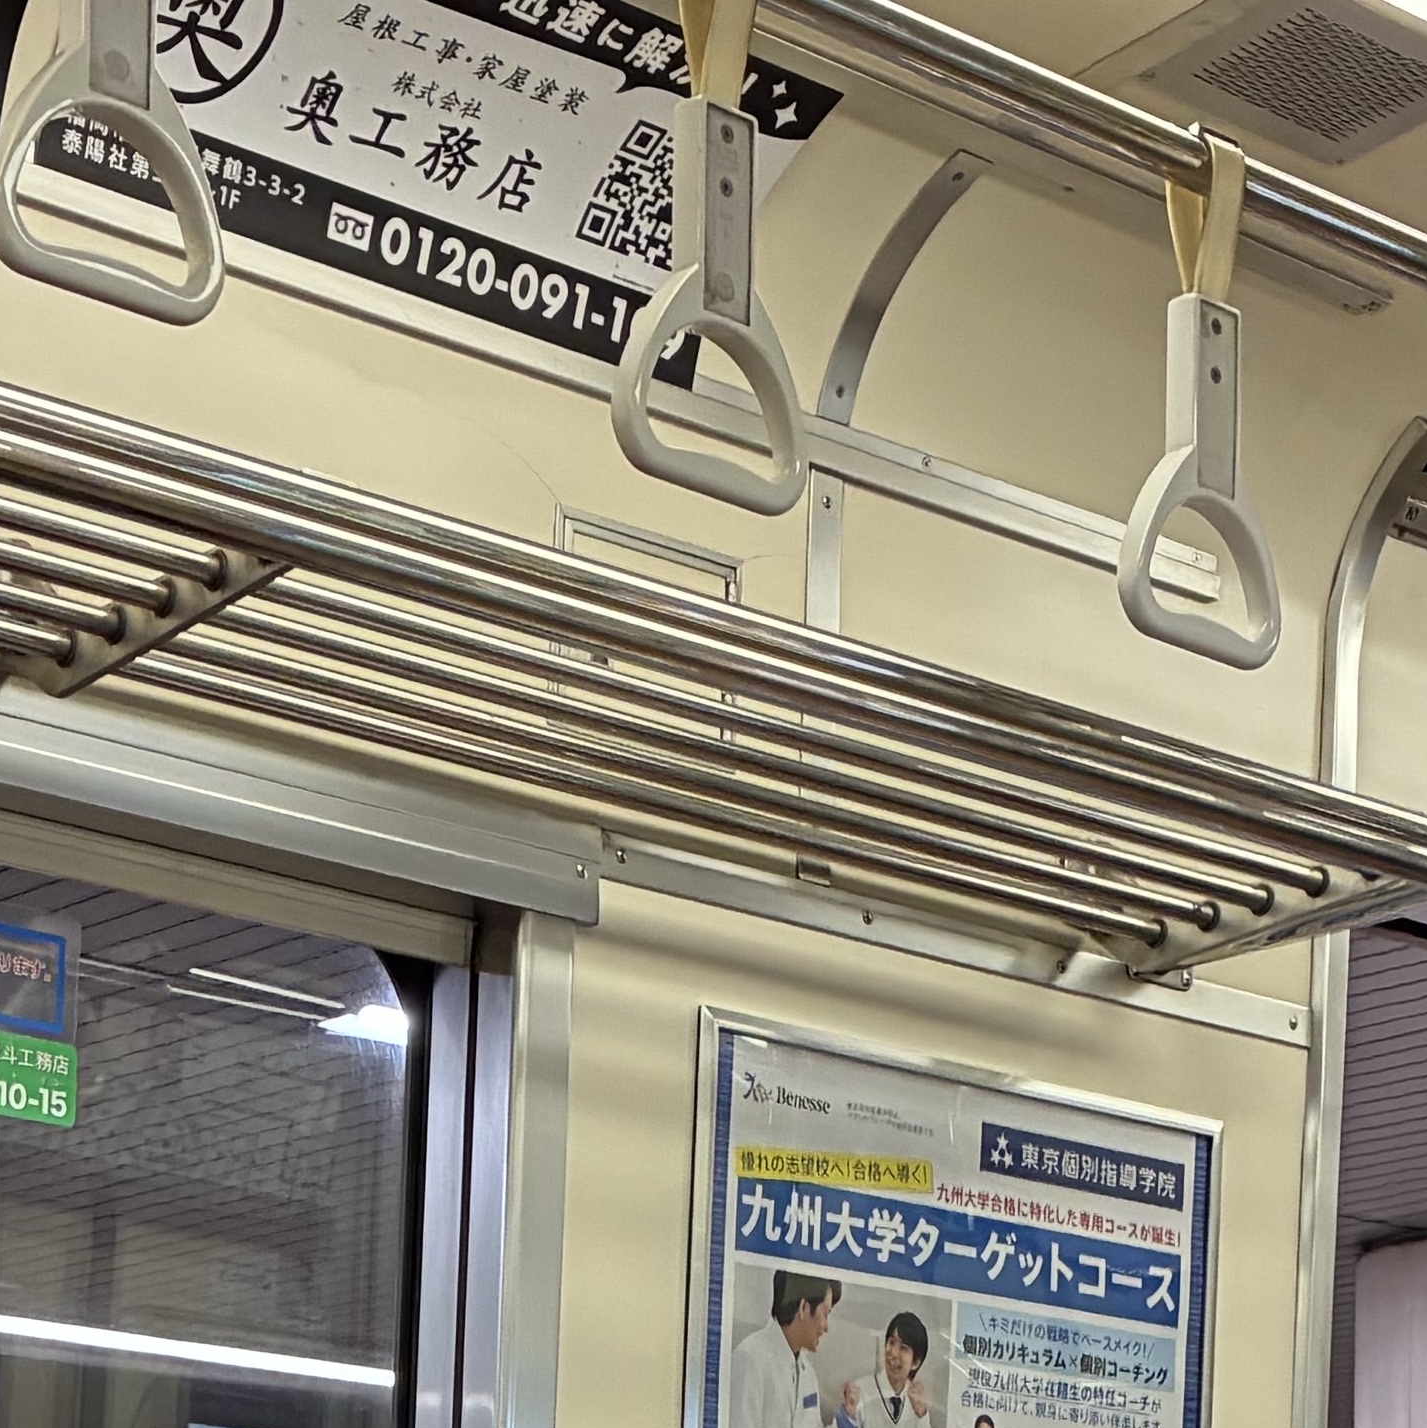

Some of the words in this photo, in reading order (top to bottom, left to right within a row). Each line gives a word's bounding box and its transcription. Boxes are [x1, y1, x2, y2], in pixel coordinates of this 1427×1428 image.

[338, 3, 590, 116] 屋根工事・家屋塗装
[391, 71, 483, 120] 株式会社
[283, 70, 543, 213] 奥工務店
[1021, 1142, 1177, 1200] 東京個別指導学院
[740, 1182, 1177, 1313] 九州大学ターゲットコース
